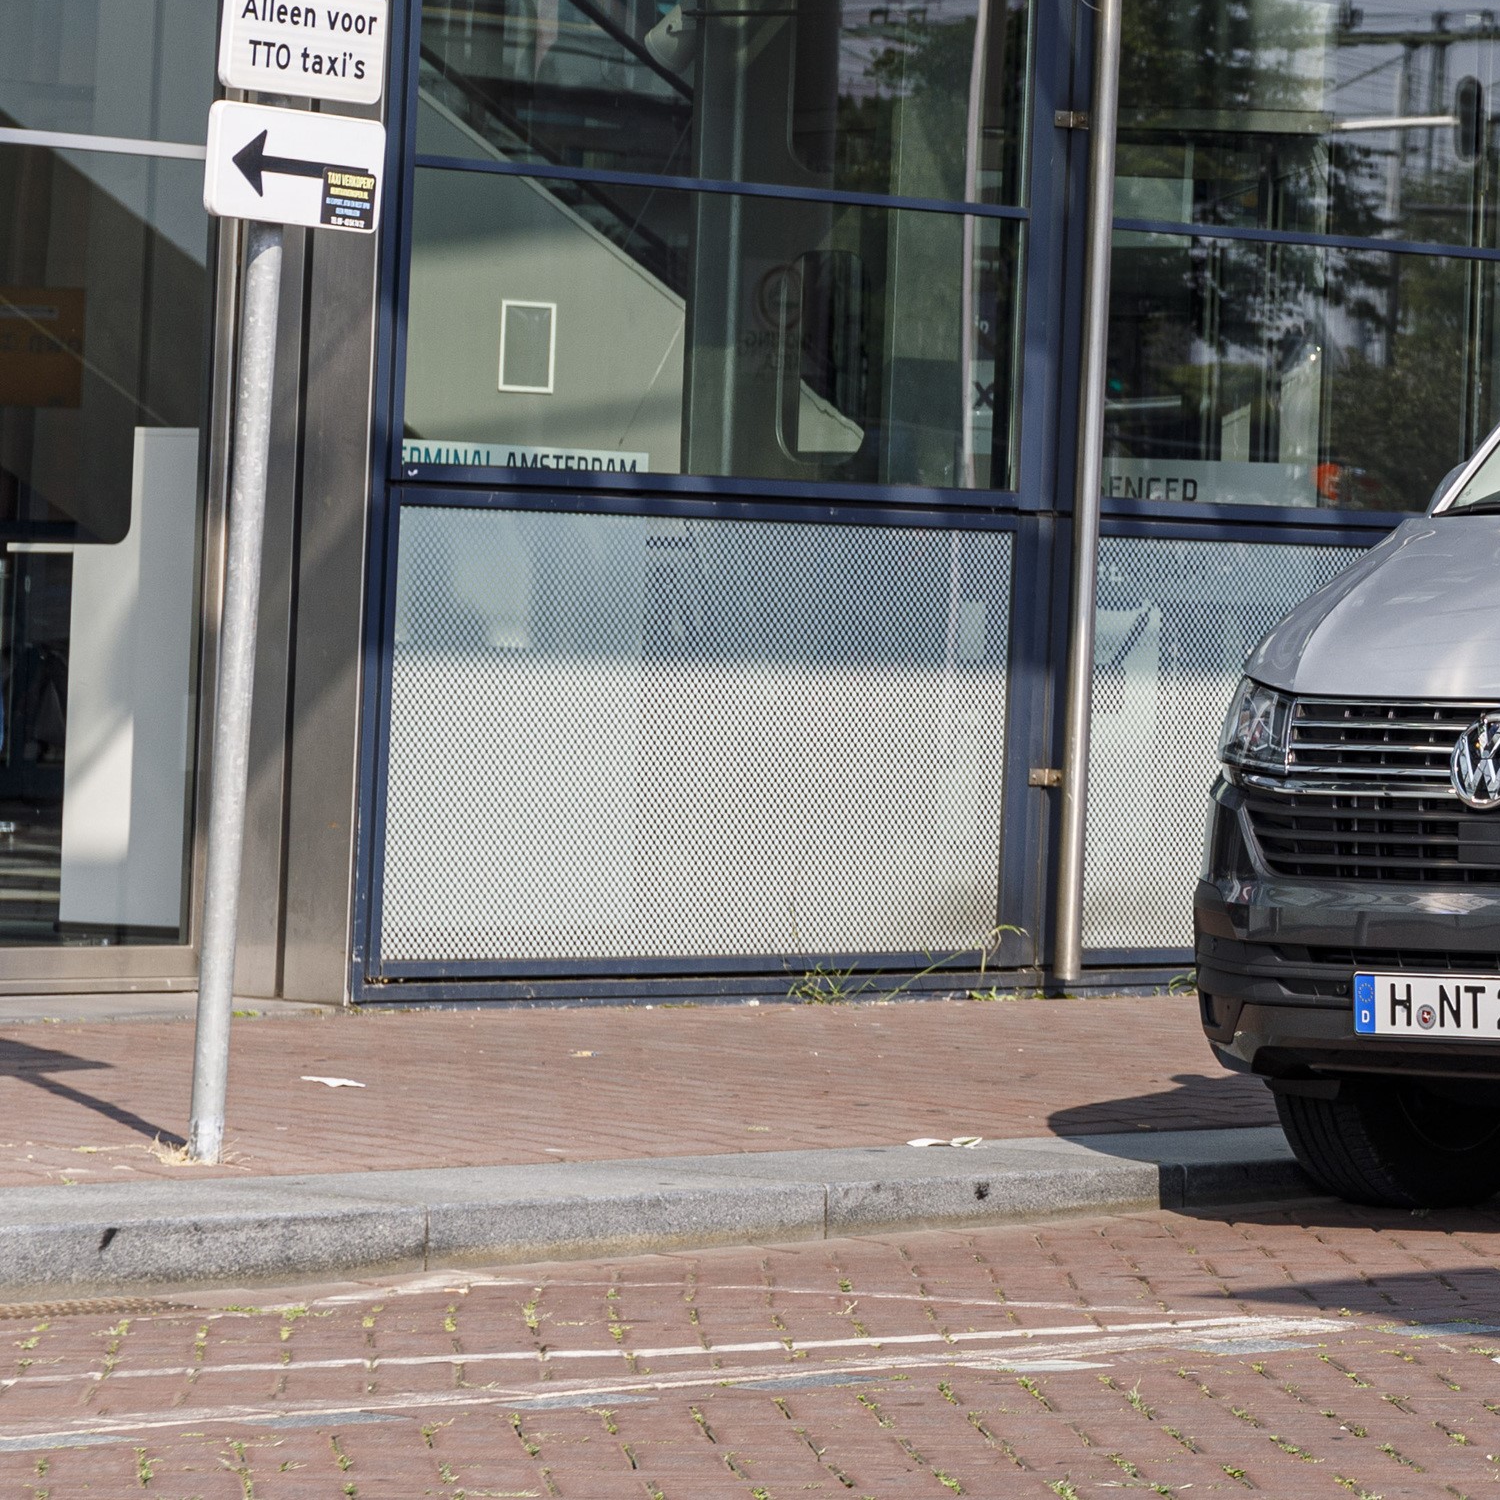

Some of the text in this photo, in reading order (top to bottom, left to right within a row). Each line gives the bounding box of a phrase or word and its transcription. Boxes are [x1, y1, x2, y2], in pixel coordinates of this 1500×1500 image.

[327, 9, 378, 36] voor
[248, 39, 366, 80] TTO taxi's
[1361, 1009, 1370, 1024] D
[1389, 982, 1412, 1027] H
[1438, 984, 1486, 1029] NT
